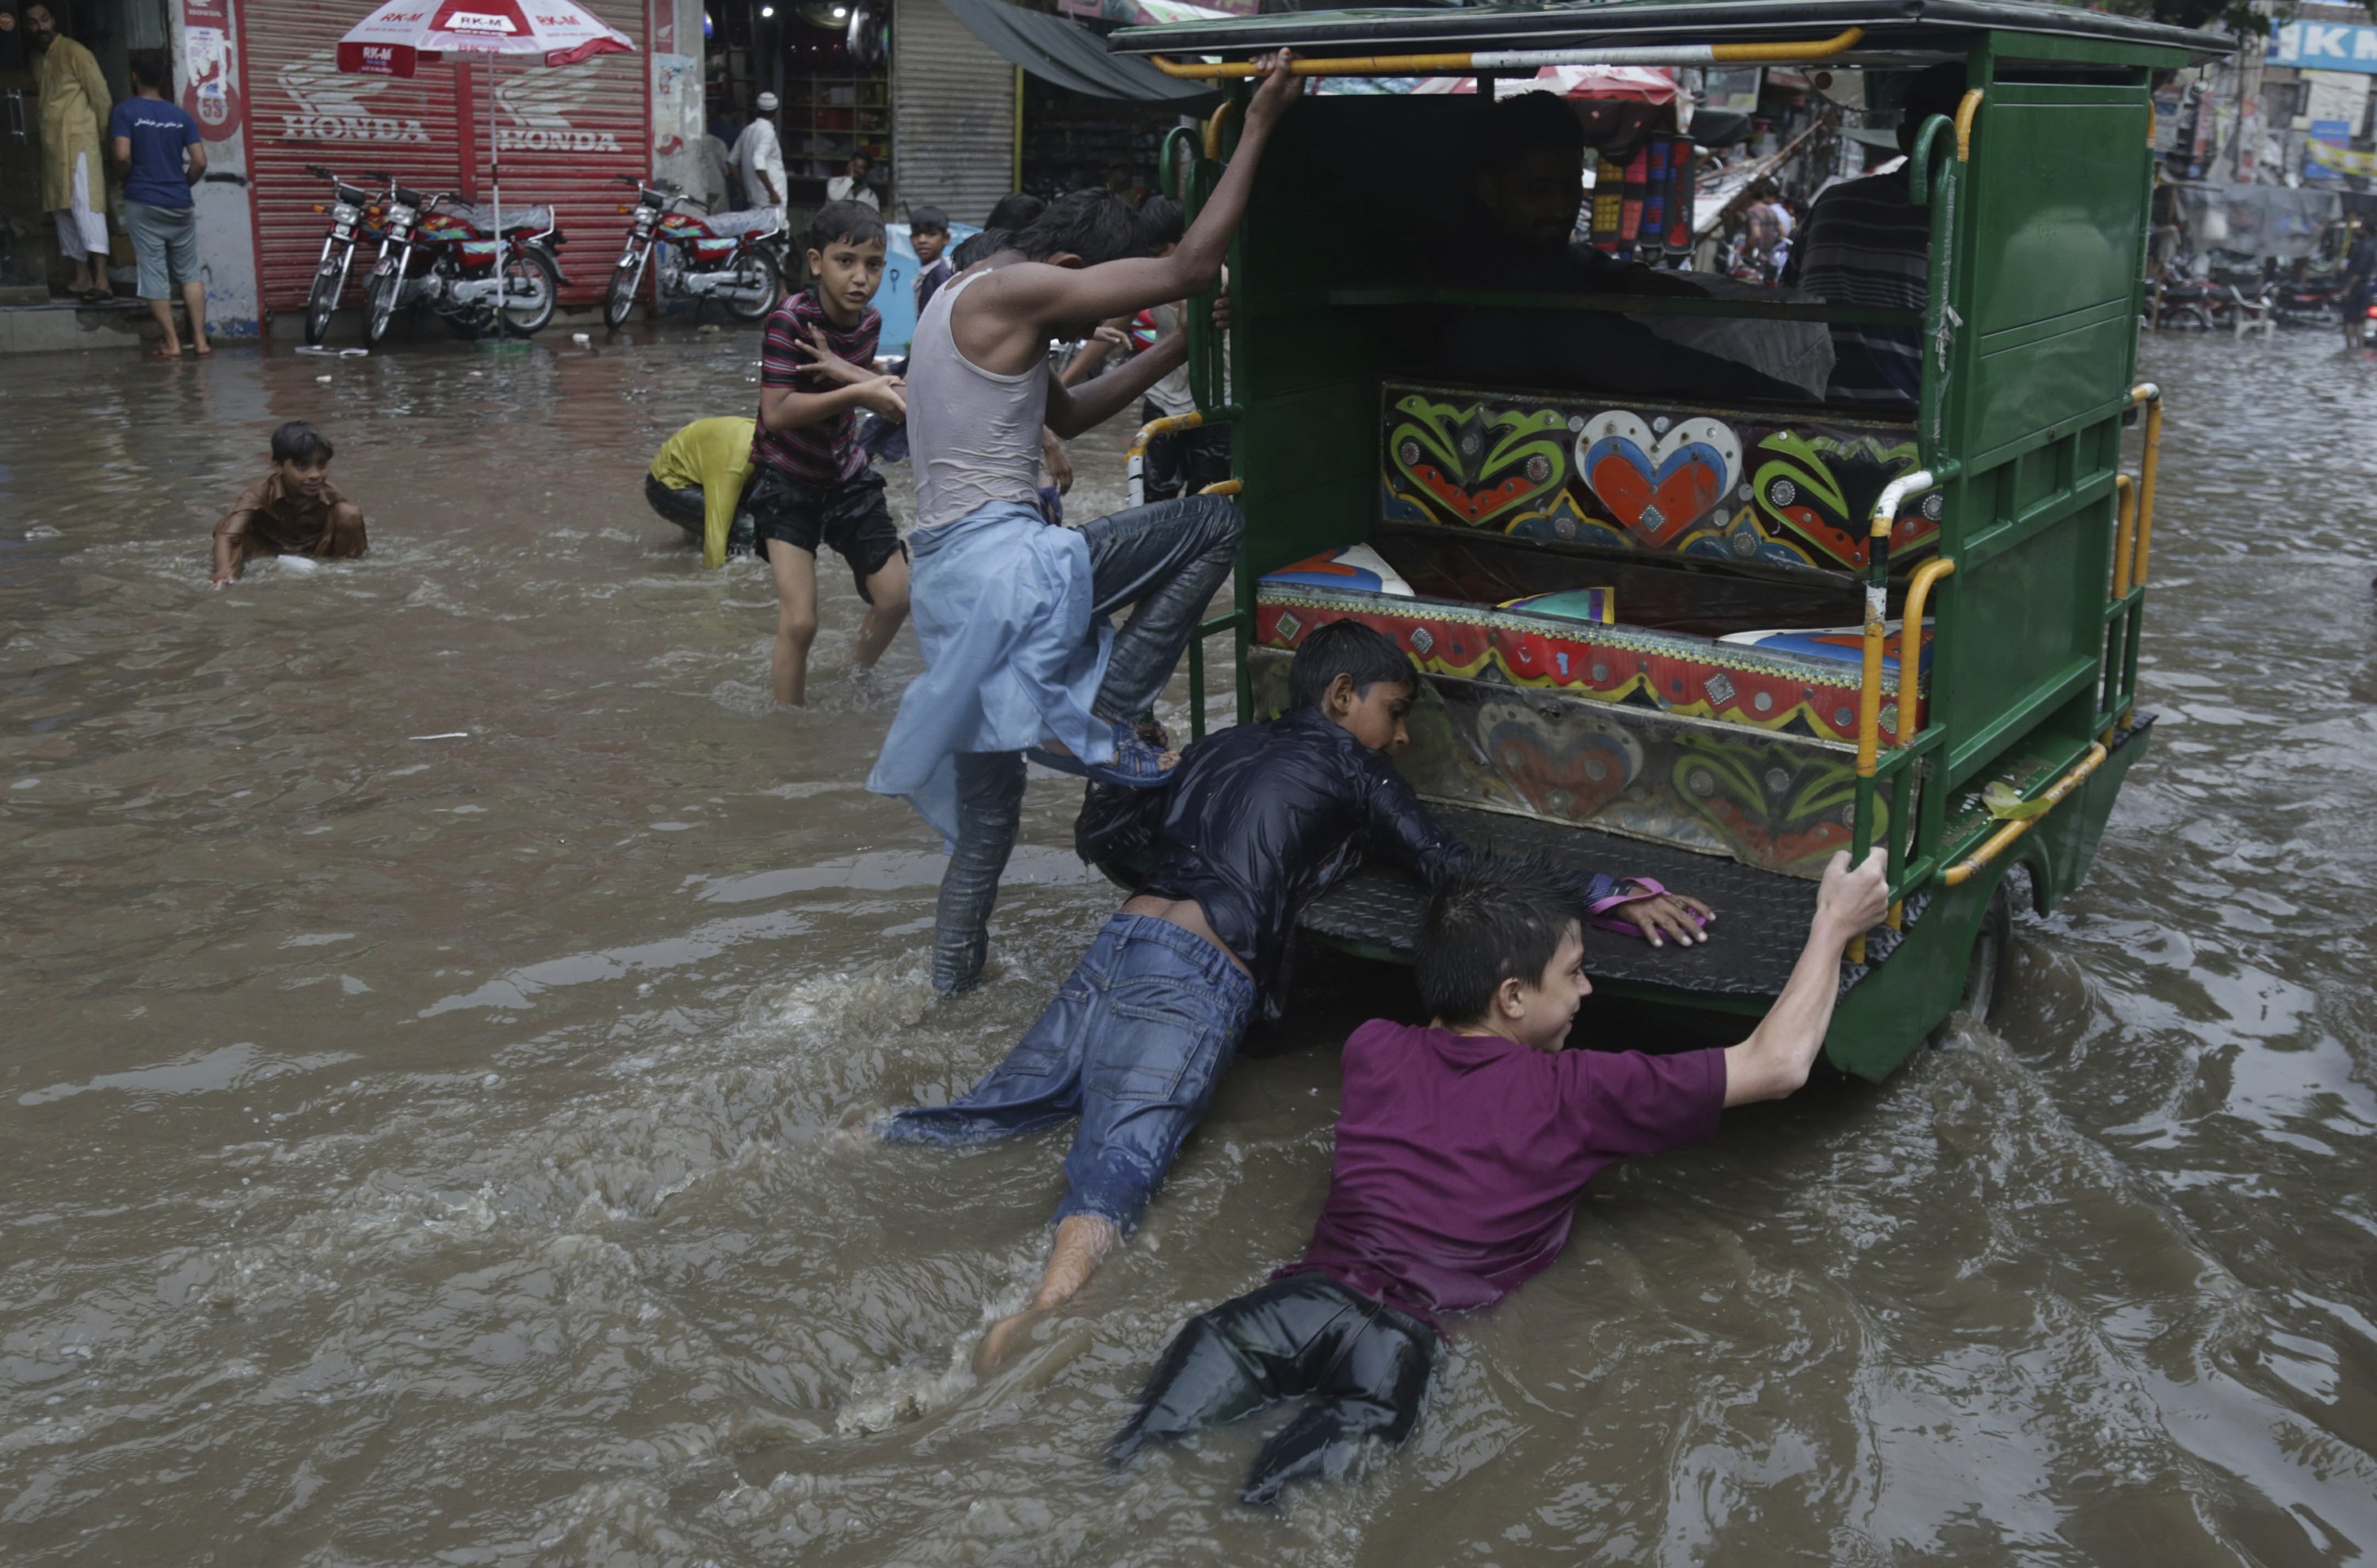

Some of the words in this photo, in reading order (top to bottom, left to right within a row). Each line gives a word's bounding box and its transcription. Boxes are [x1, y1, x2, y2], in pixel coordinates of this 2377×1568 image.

[188, 9, 223, 17] HONDA
[380, 13, 425, 22] RK-M
[461, 17, 502, 27] RK-M
[536, 15, 581, 26] RK-M
[363, 47, 394, 60] RK-M
[281, 115, 431, 143] HONDA
[497, 129, 623, 151] HONDA
